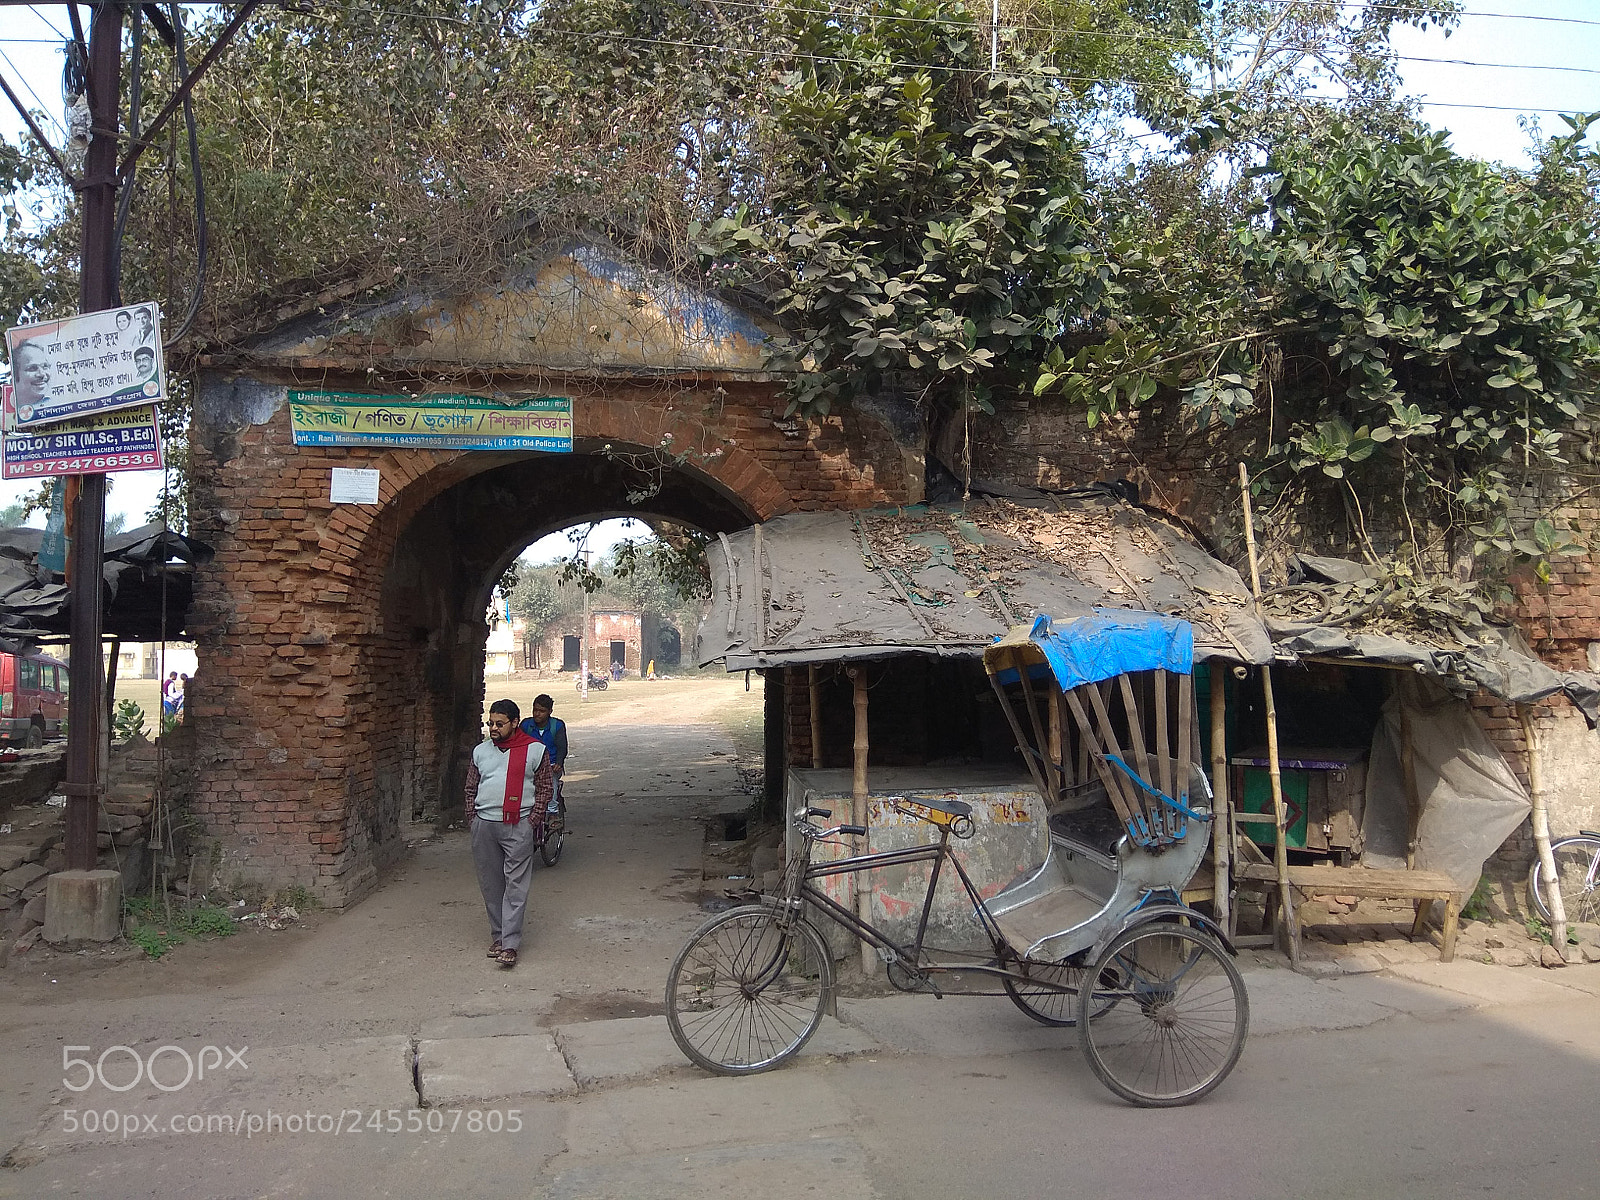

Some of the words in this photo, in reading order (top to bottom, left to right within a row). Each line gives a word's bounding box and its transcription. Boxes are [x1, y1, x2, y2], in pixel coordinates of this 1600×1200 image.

[64, 339, 75, 350] এক
[297, 392, 331, 403] Unique
[107, 413, 152, 426] ADVANCE
[292, 405, 349, 426] ইংরাজী
[352, 410, 362, 429] /
[365, 408, 407, 428] গণিত
[409, 411, 420, 430] /
[421, 413, 475, 432] ভূগোল
[6, 436, 53, 452] MOLOY
[55, 434, 77, 448] SIR
[79, 431, 119, 449] (M.Sc,
[120, 428, 155, 443] B.Ed)
[295, 434, 311, 442] ont.
[318, 434, 334, 442] Rani
[335, 435, 361, 443] Madam
[20, 453, 42, 461] SCHOOL
[42, 450, 67, 459] TEACHER
[90, 446, 115, 454] TEACHER
[123, 443, 155, 452] PATHFINDER
[9, 452, 155, 475] M-9734766536
